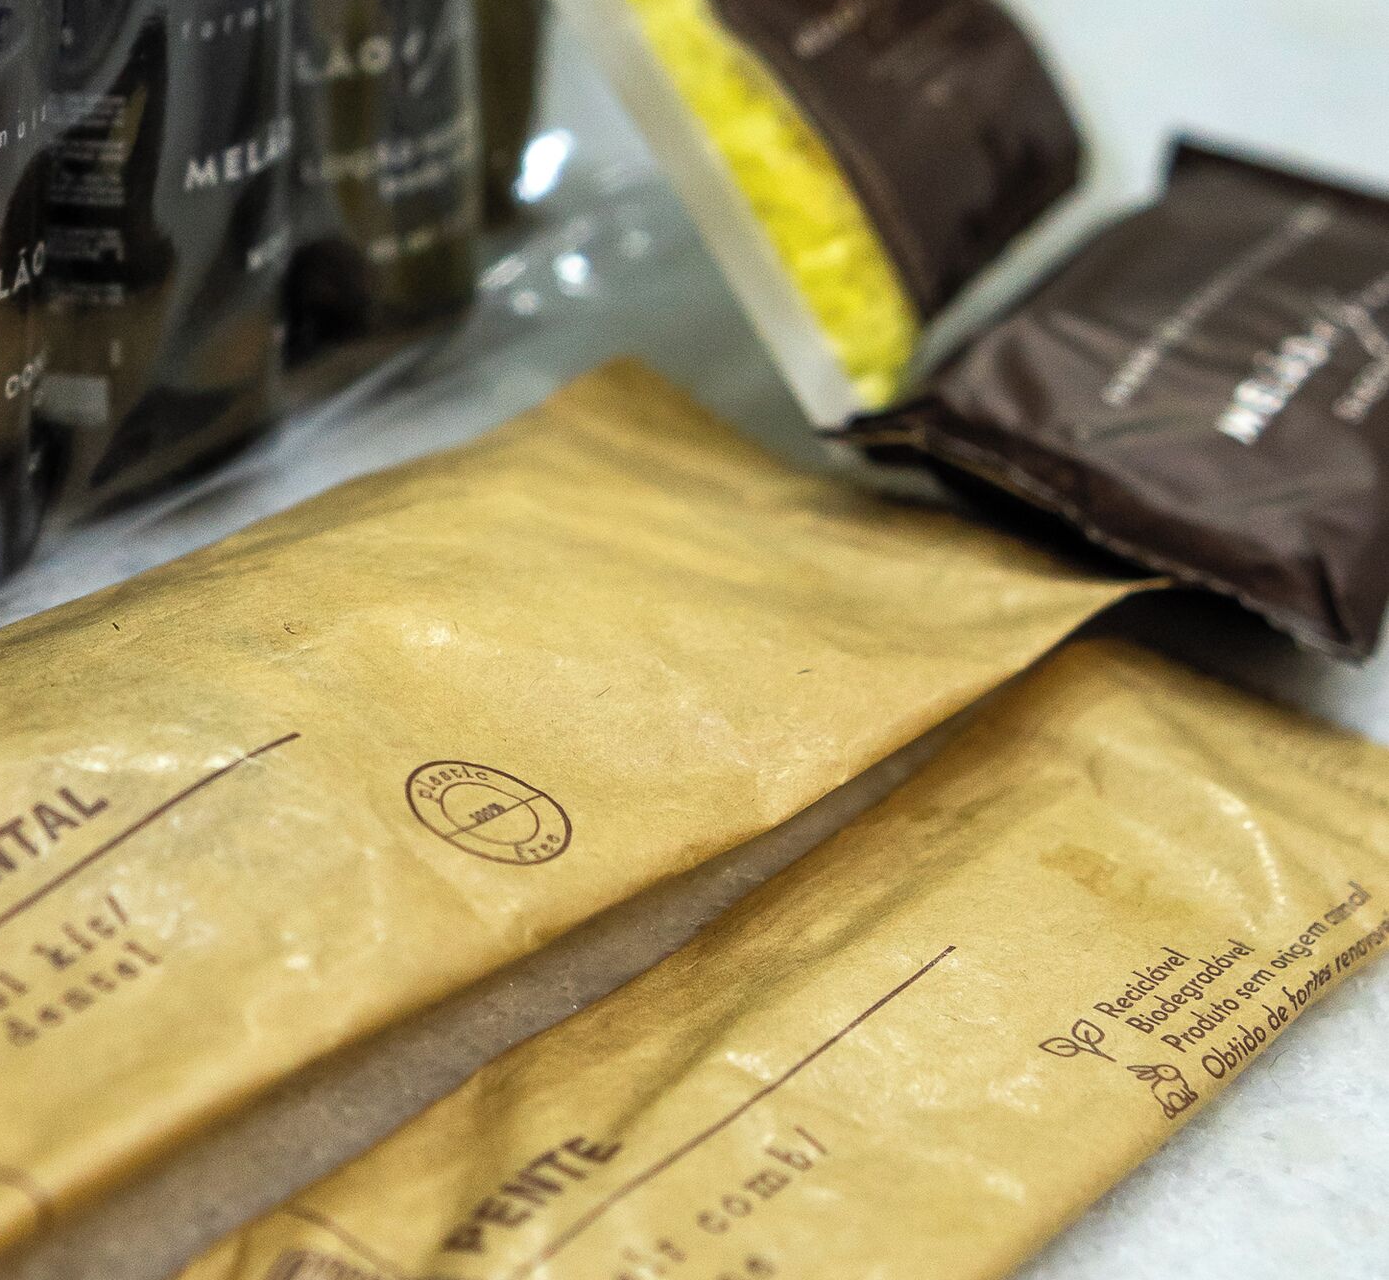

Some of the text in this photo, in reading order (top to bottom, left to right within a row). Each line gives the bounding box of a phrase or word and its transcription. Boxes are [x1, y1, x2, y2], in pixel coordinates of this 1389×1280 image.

[414, 766, 489, 804] plastic
[1093, 946, 1191, 1019] Reciclável
[1125, 938, 1255, 1034] Biodegradável
[1160, 998, 1239, 1053] Produto
[1236, 969, 1276, 999] sem
[1270, 921, 1329, 969] origem
[1201, 1024, 1267, 1079] Obtido
[1262, 1004, 1288, 1031] de
[441, 1136, 624, 1254] PENTE
[697, 1124, 828, 1235] comb/
